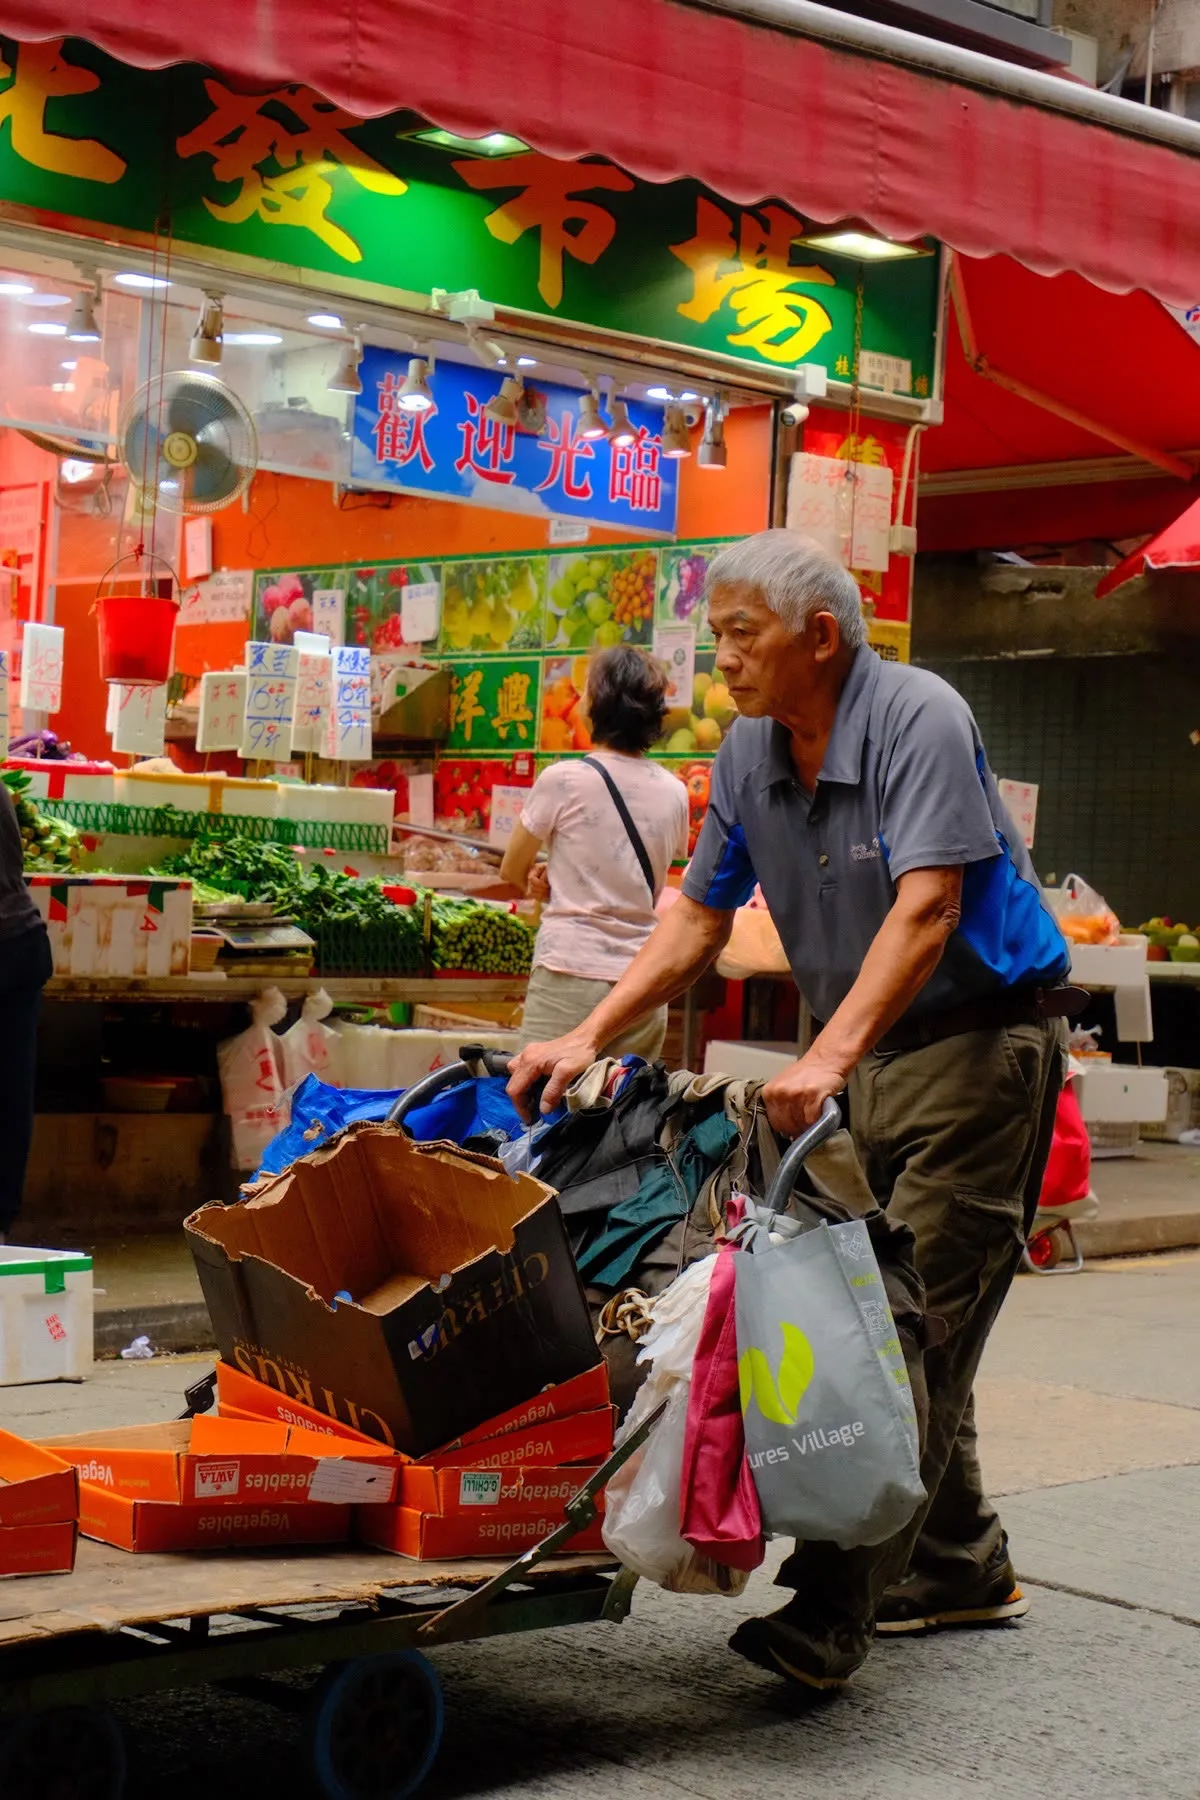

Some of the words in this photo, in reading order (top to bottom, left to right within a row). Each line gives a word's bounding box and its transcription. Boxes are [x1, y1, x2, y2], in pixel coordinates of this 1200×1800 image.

[372, 372, 663, 512] 歡迎光臨
[792, 1421, 865, 1455] Village
[199, 1470, 236, 1484] AWLA
[463, 1478, 498, 1492] G.CHILLI
[500, 1481, 582, 1502] egetables
[198, 1509, 290, 1532] Vegetables
